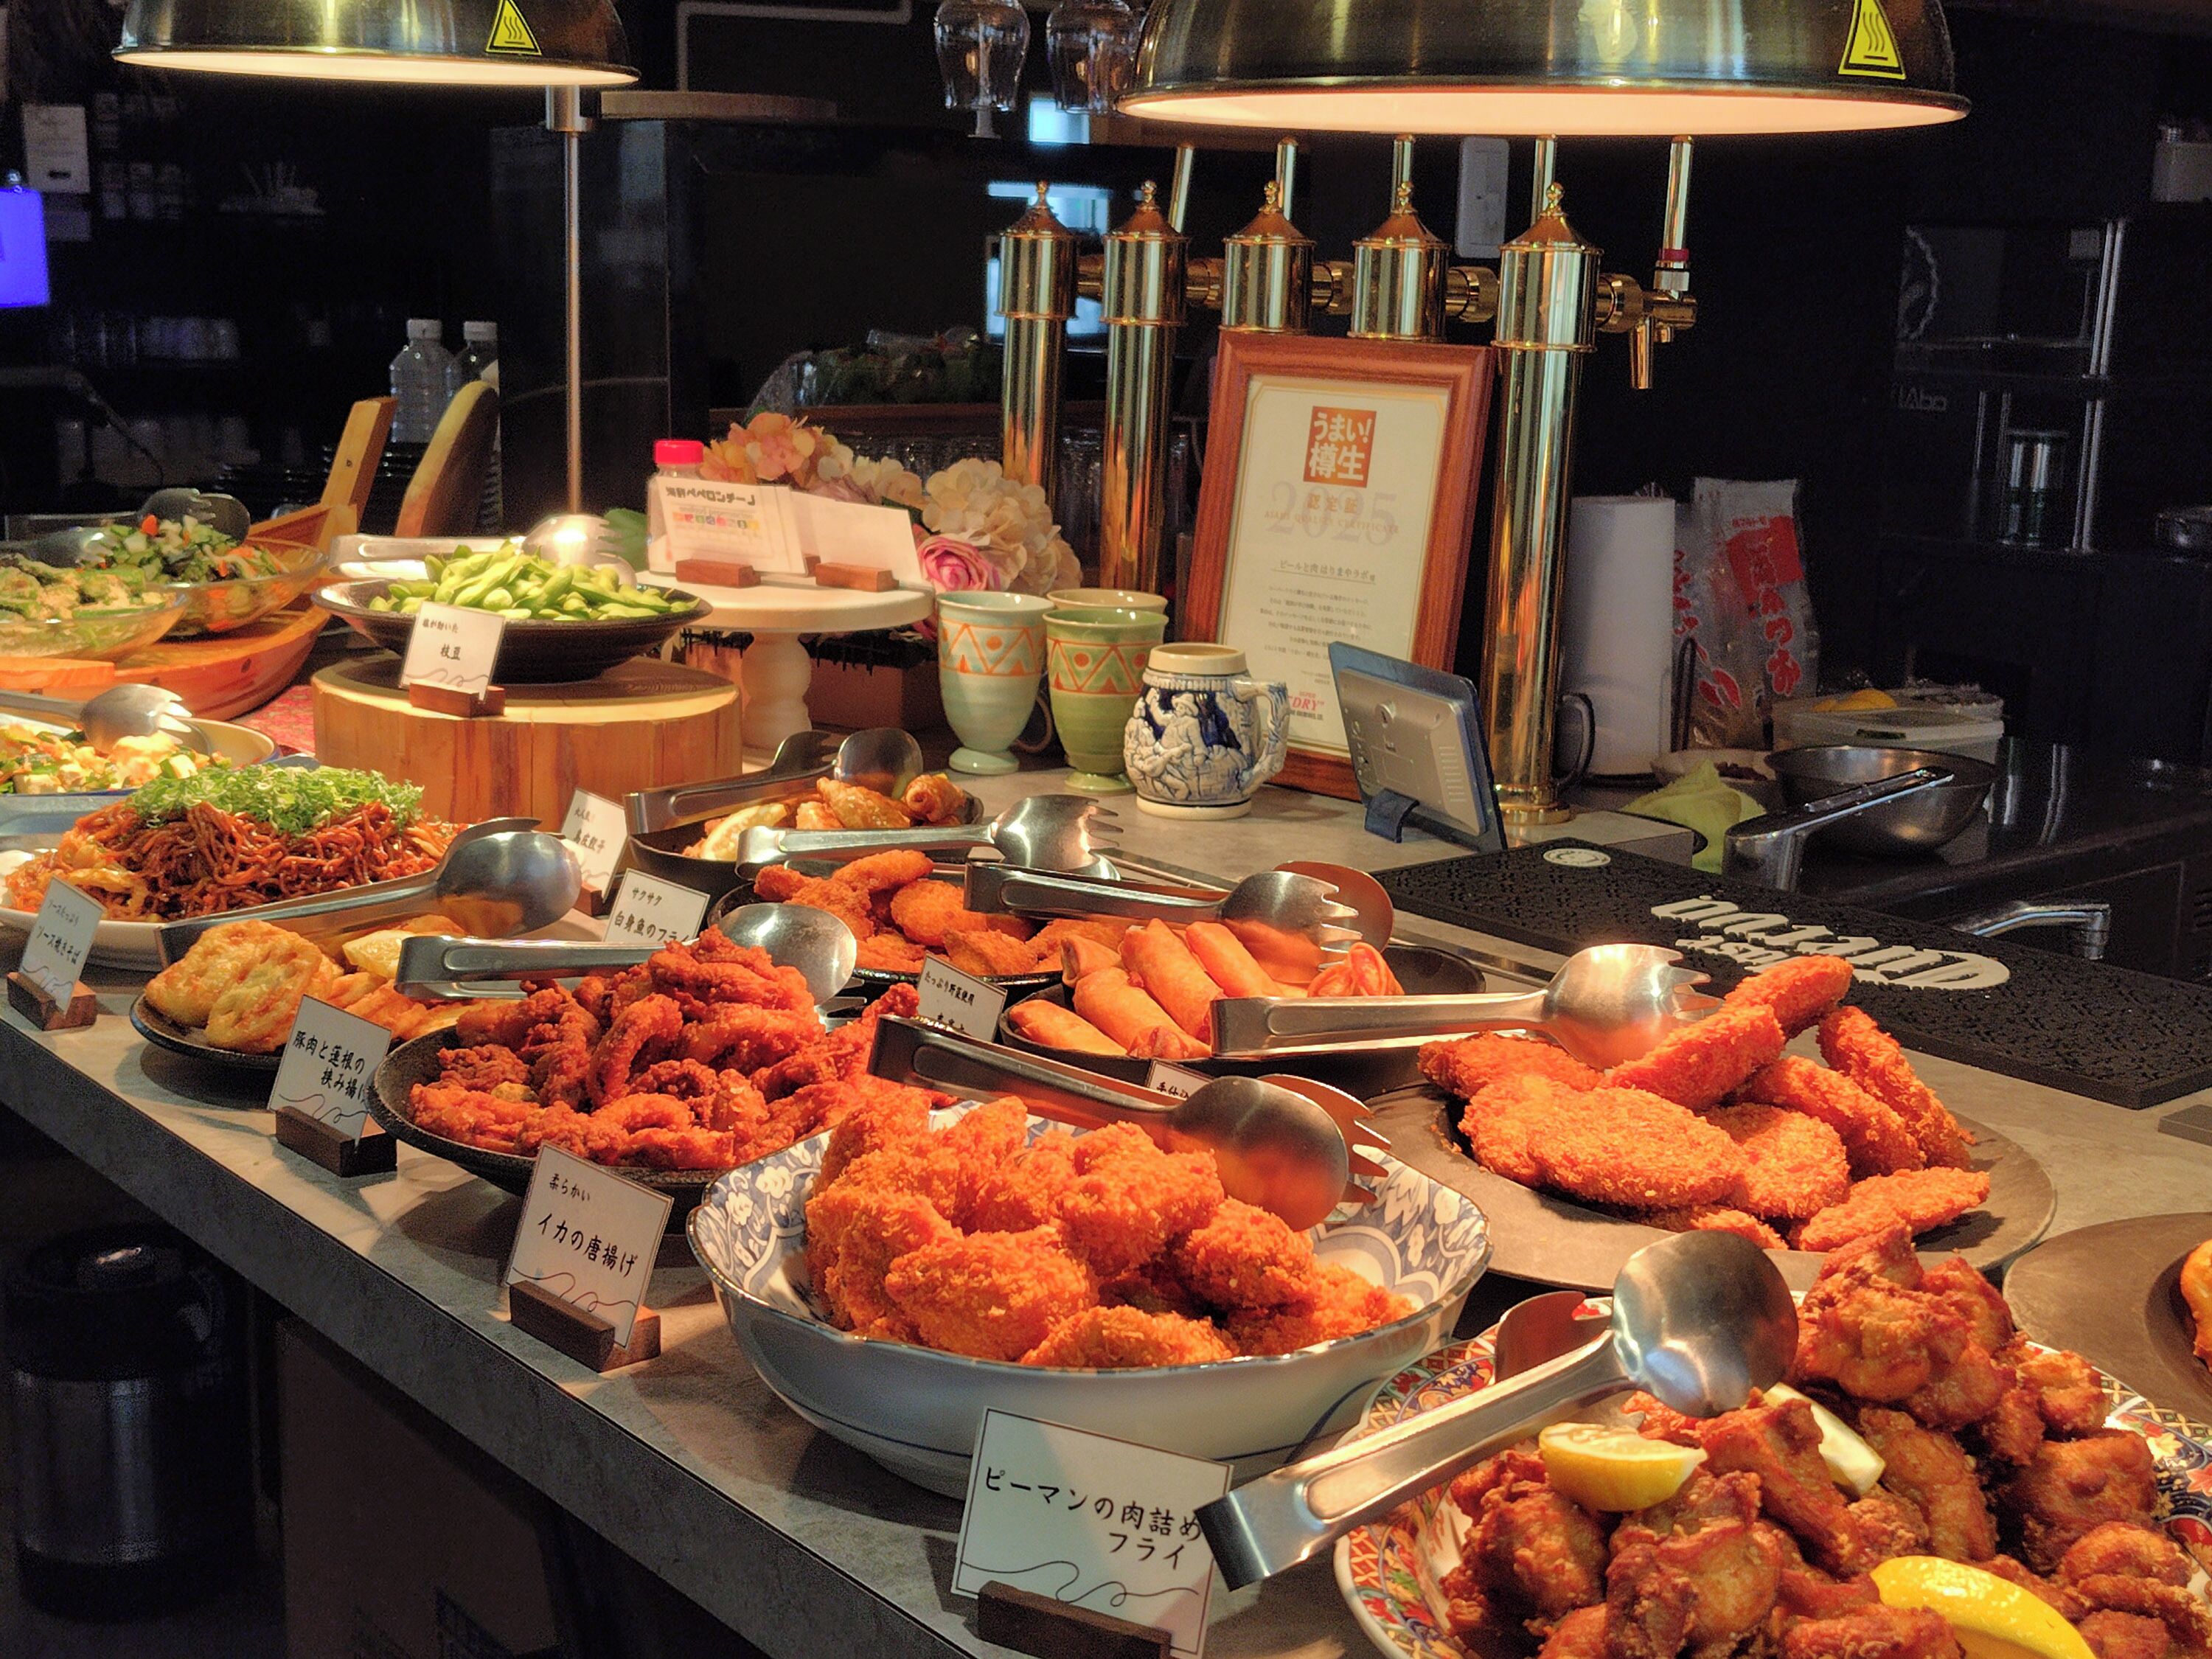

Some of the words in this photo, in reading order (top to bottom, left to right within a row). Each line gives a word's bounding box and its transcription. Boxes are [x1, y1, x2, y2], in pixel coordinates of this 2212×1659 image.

[1309, 441, 1364, 481] 樽生
[1263, 480, 1398, 546] 2025
[441, 643, 461, 661] 枝豆
[633, 887, 662, 906] サクサク
[37, 925, 81, 965] ソース焼きそば
[293, 1030, 366, 1075] 豚肉と蓮根の
[549, 1172, 591, 1203] 柔らかい
[538, 1212, 639, 1279] イカの唐揚げ
[985, 1466, 1203, 1543] ピーマンの肉詰め
[1108, 1532, 1186, 1571] フライ
